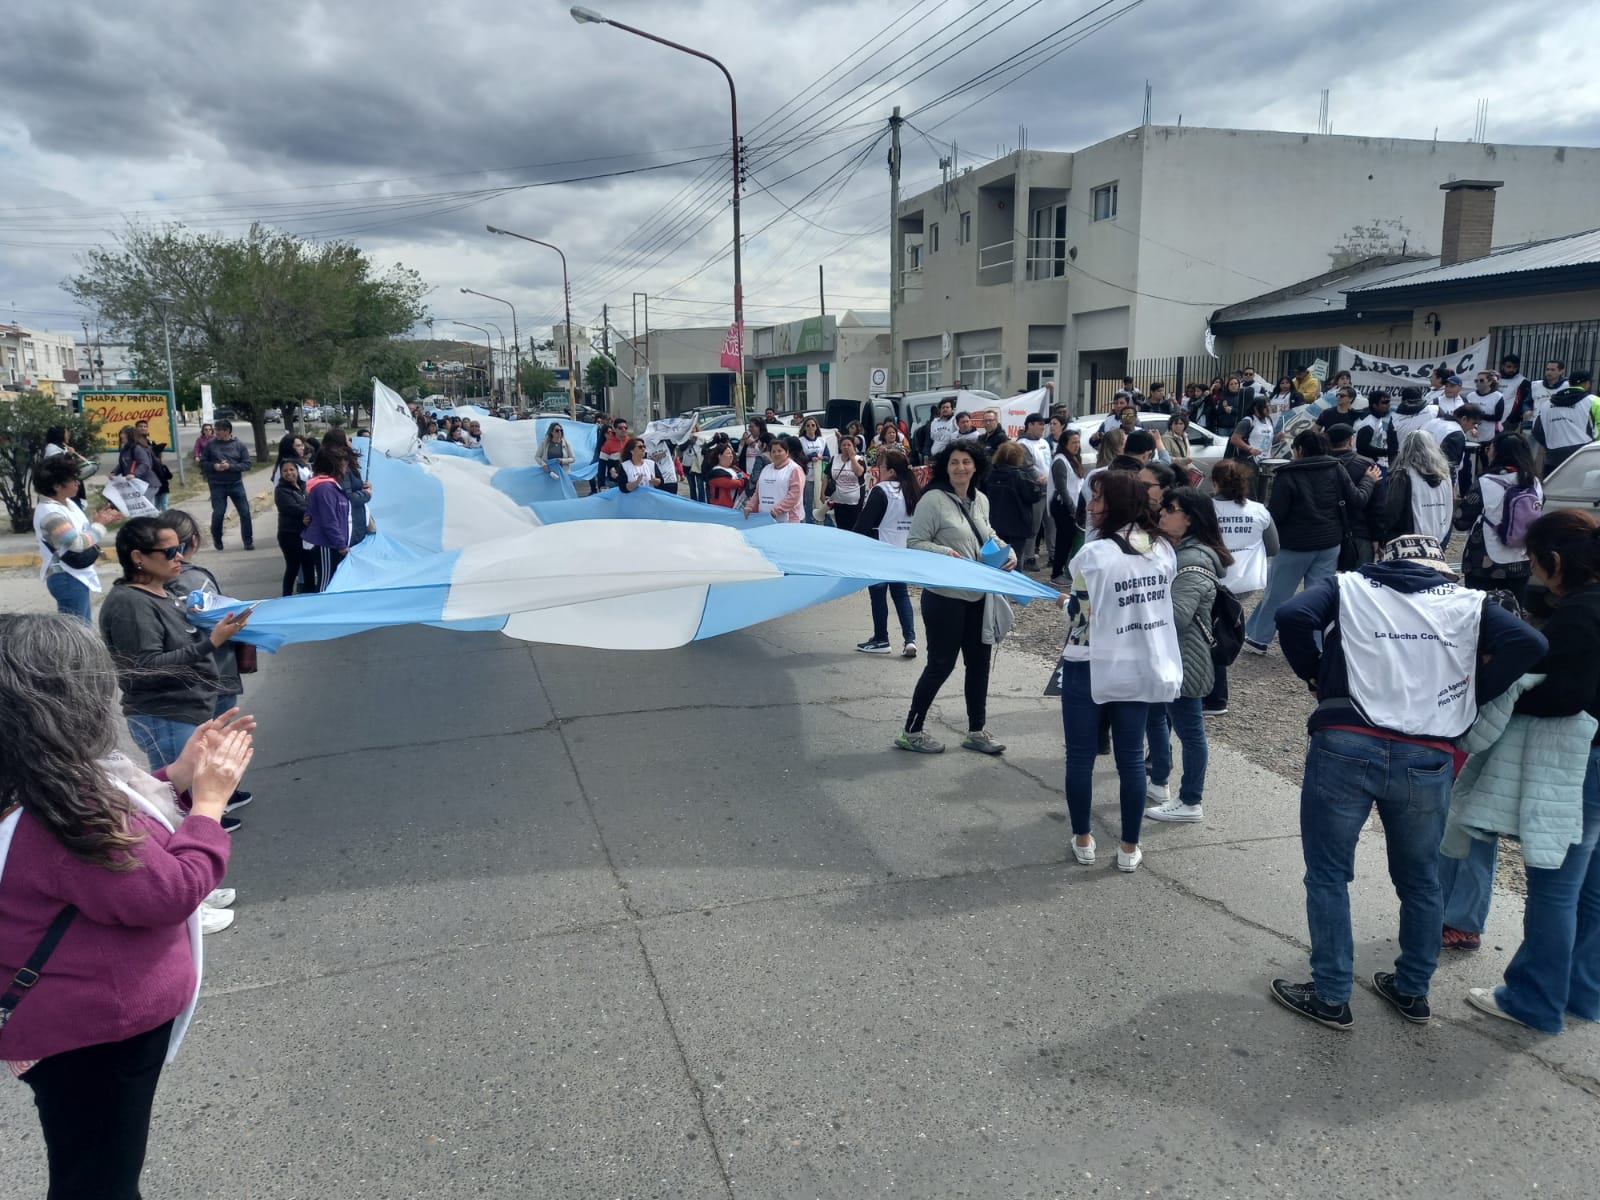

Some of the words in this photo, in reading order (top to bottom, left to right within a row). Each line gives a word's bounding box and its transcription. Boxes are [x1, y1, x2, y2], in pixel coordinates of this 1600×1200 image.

[119, 394, 126, 402] Y
[1234, 526, 1252, 534] CRUZ
[1114, 575, 1157, 593] DOCENTES
[1118, 593, 1146, 607] SANTA
[1146, 589, 1165, 602] CRUZ
[1116, 627, 1124, 635] LA
[1374, 631, 1387, 639] La
[1388, 632, 1418, 640] Lucha
